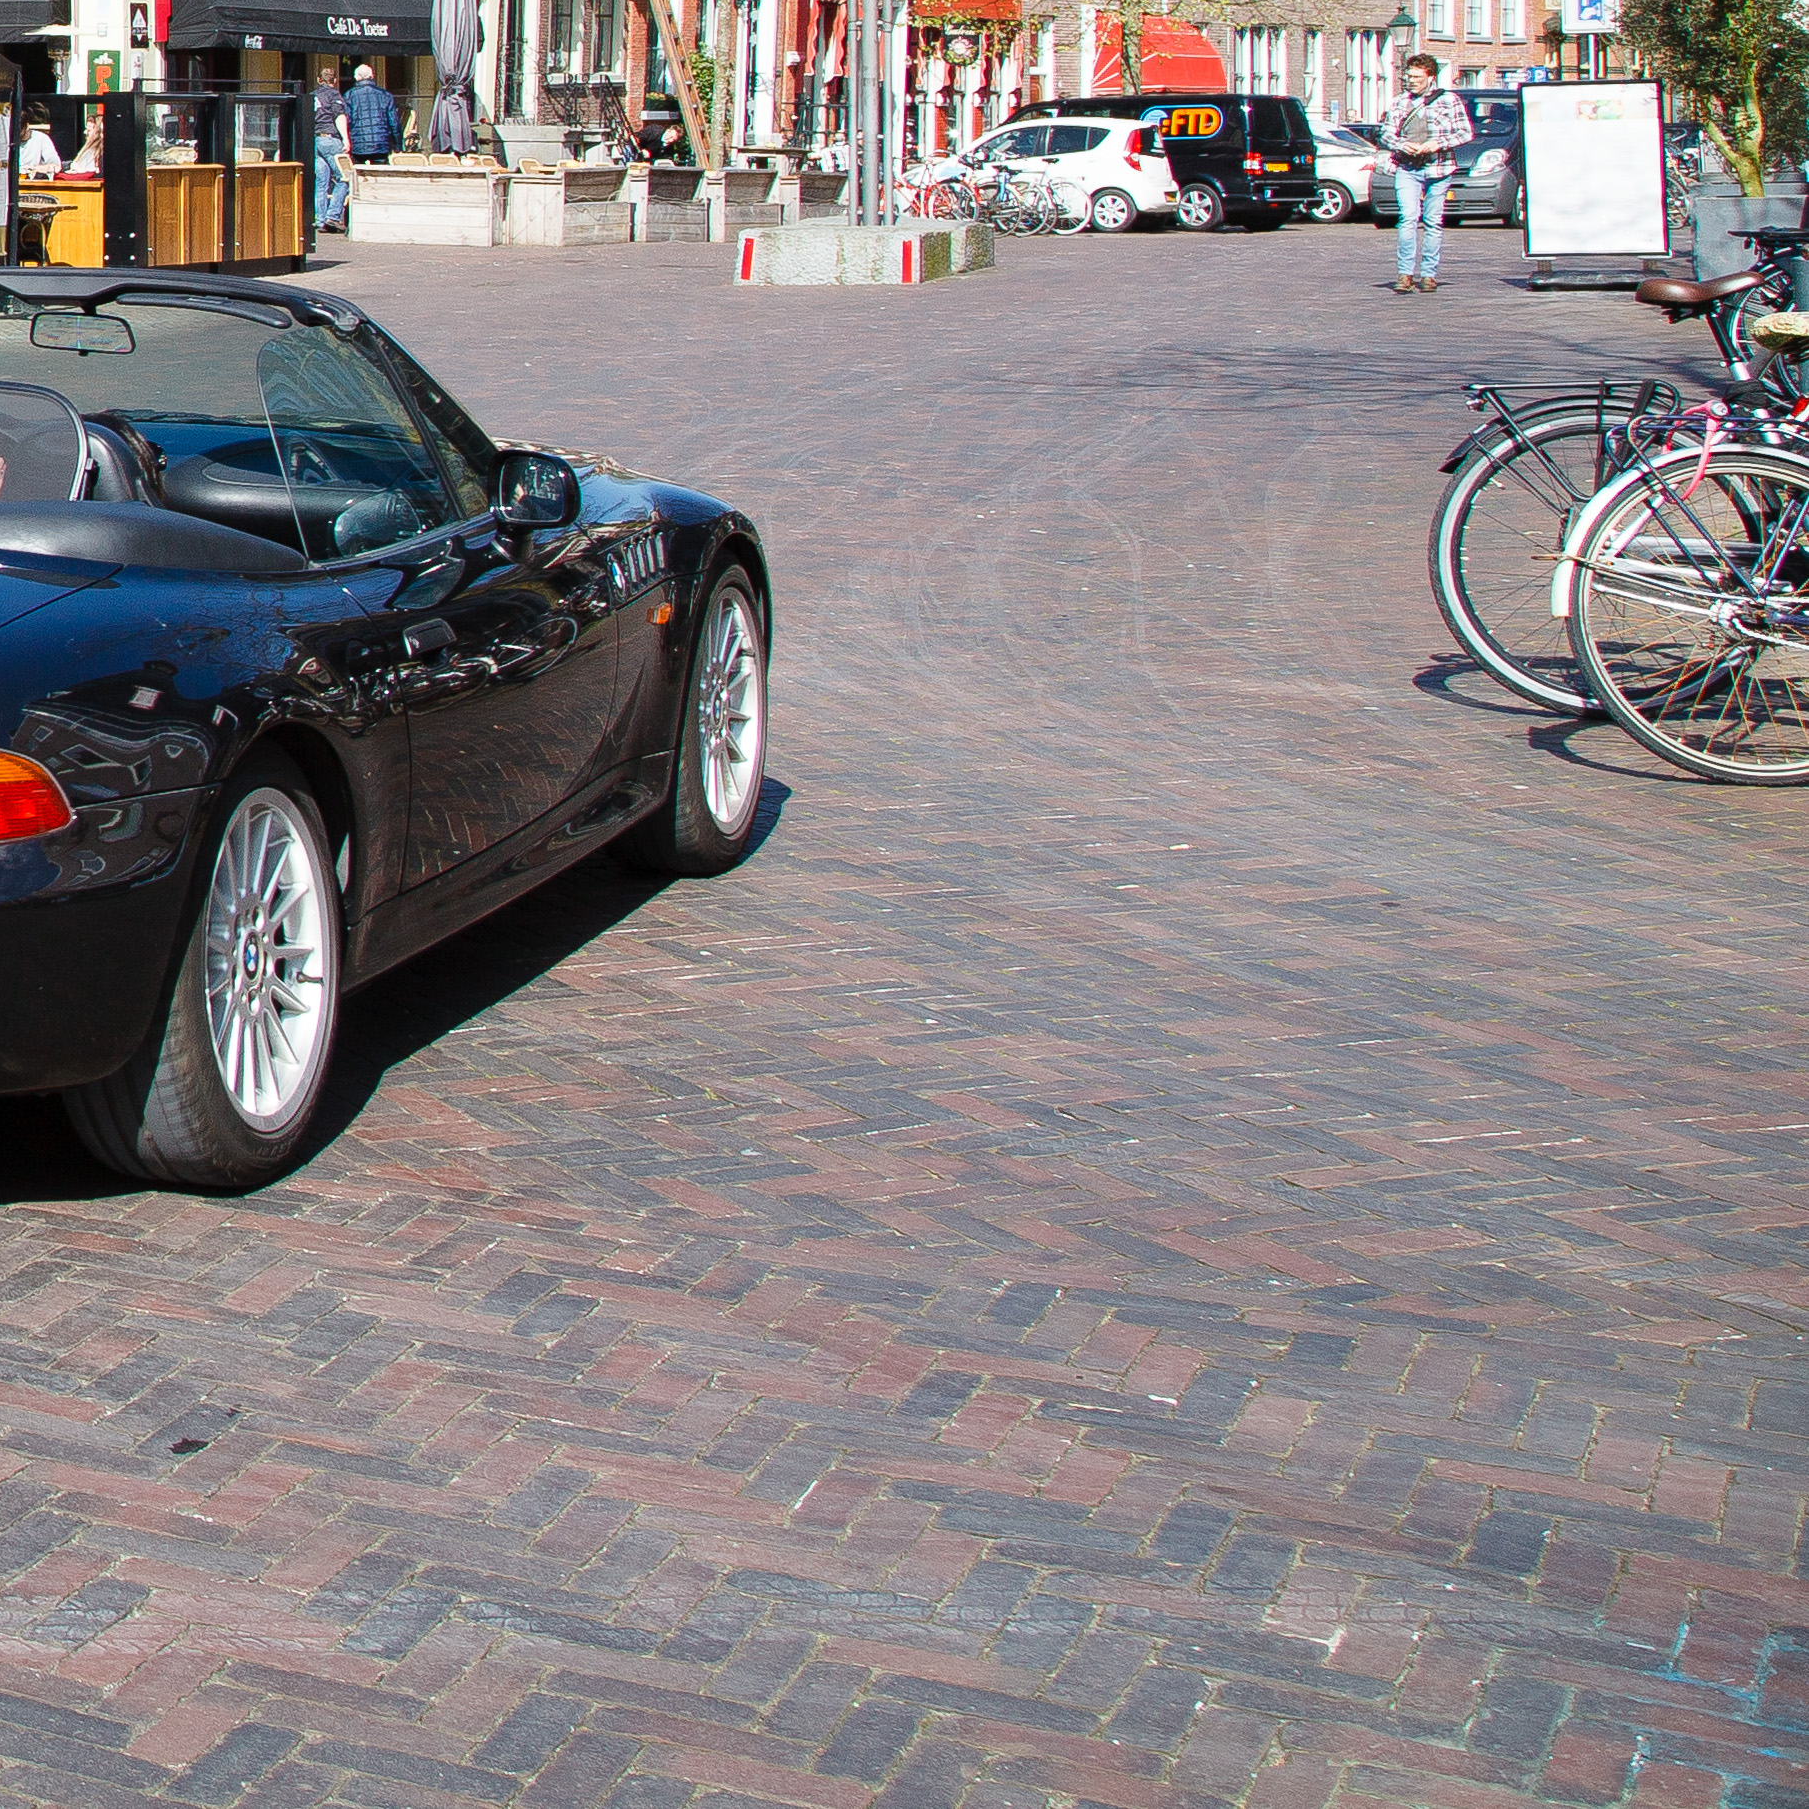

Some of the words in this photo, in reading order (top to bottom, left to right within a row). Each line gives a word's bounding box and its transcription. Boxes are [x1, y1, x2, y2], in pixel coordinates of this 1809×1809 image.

[326, 16, 348, 36] Café
[347, 18, 361, 35] De
[360, 19, 389, 36] Toeter
[1170, 107, 1221, 136] FTD
